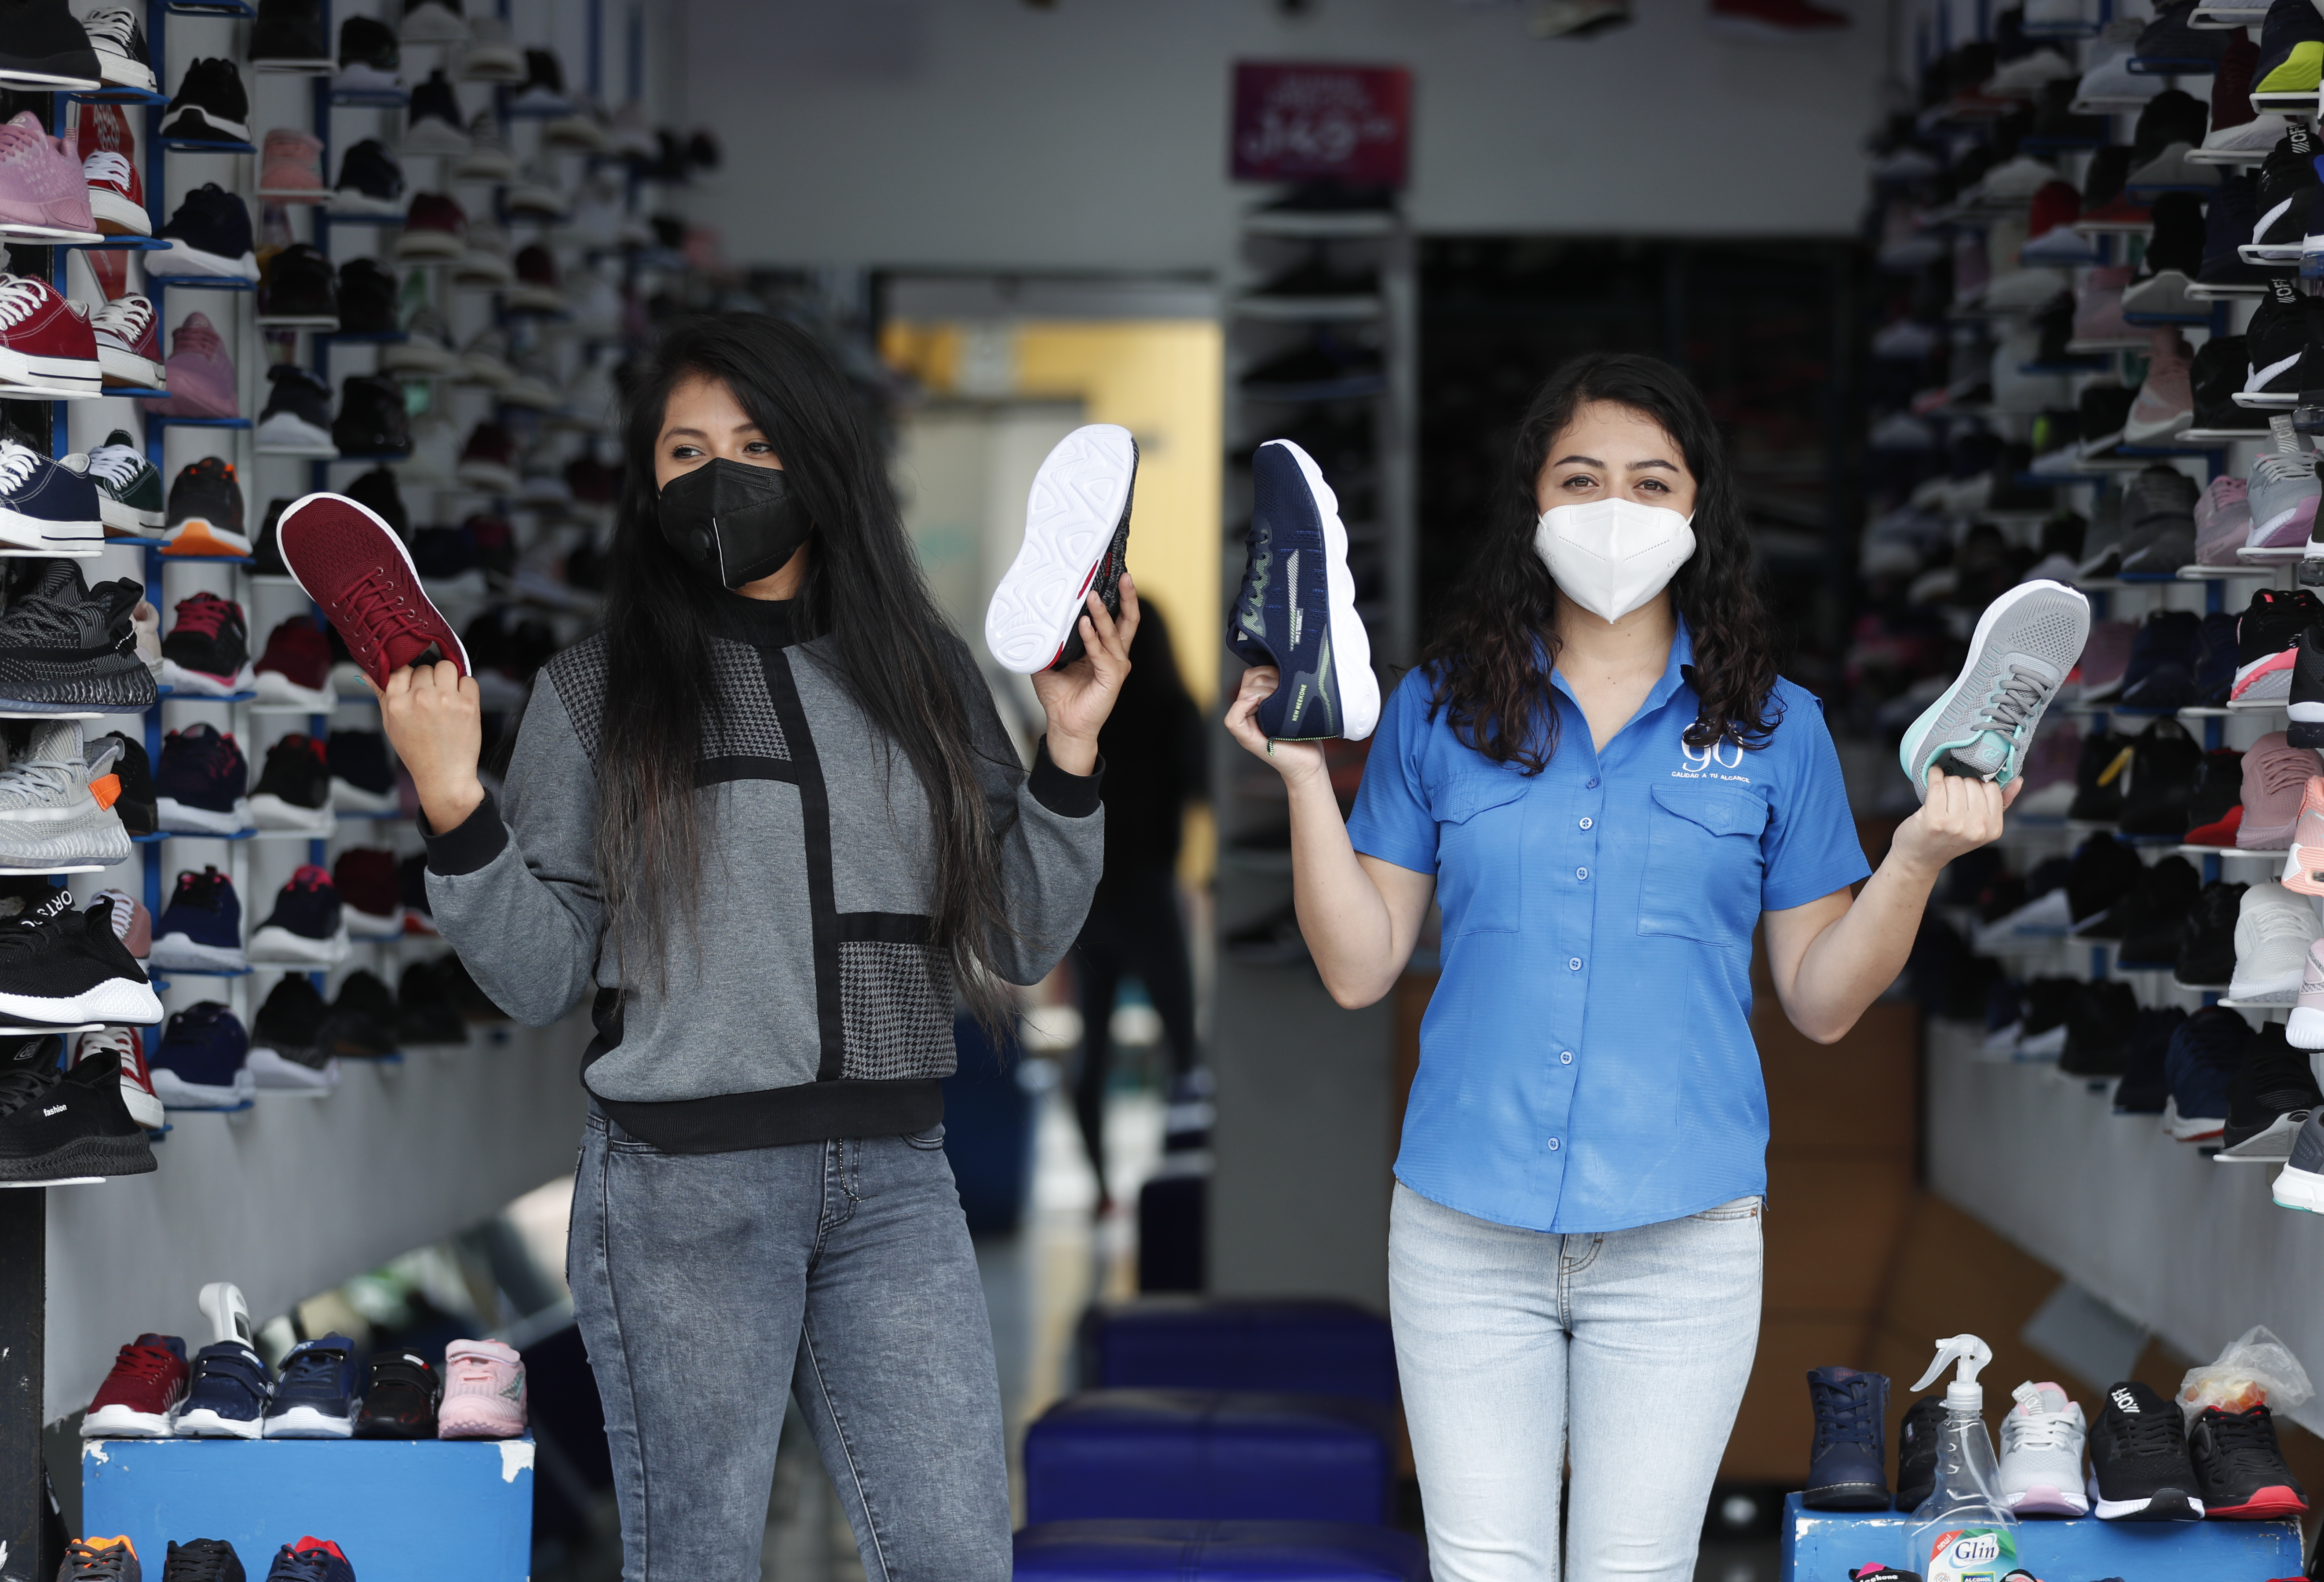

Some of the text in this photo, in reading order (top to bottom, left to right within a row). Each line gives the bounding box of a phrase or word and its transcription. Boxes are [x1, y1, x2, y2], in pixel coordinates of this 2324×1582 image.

[1295, 684, 1307, 710] MEEKONE
[1681, 723, 1743, 772] 90
[1720, 775, 1750, 783] ALCANCE
[43, 1104, 67, 1117] fashion
[1937, 1534, 1953, 1551] new!
[1955, 1542, 1995, 1559] Glin
